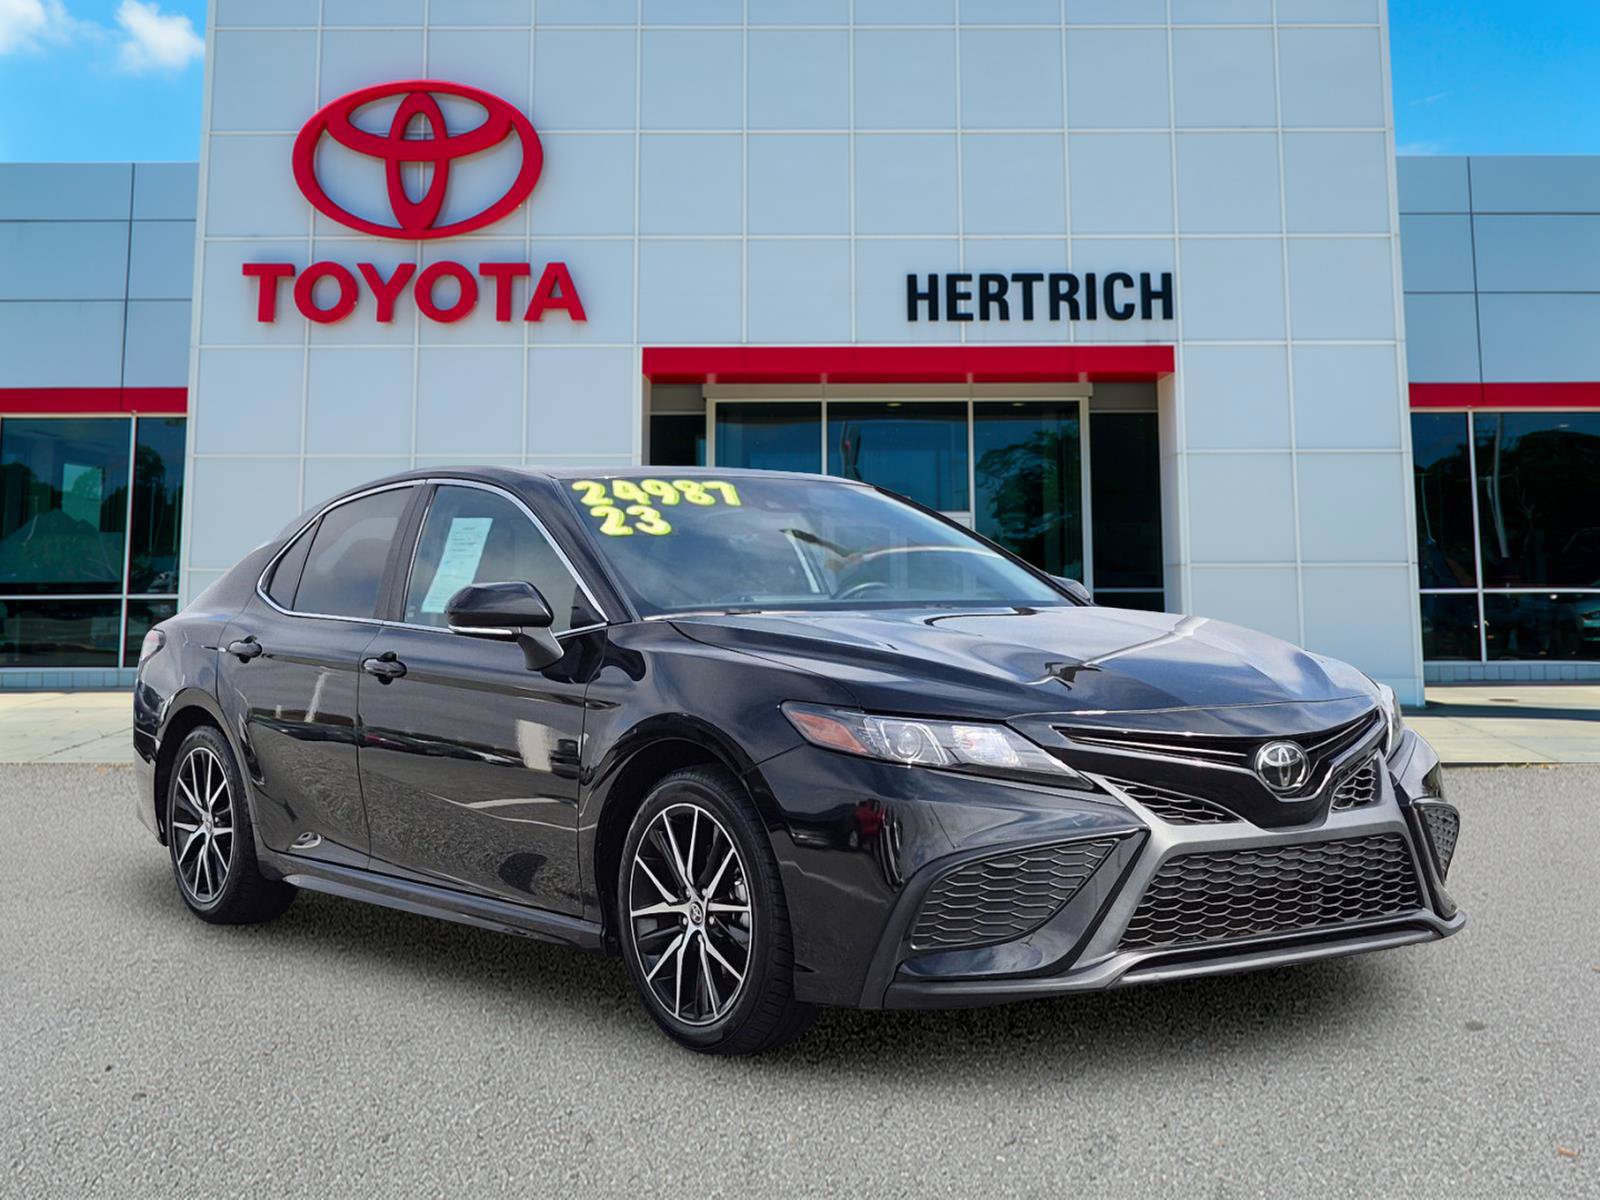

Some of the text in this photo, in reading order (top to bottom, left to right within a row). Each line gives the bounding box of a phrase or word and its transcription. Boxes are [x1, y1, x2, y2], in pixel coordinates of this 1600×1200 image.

[242, 261, 587, 323] TOYOTA
[906, 272, 1174, 322] HERTRICH
[571, 479, 742, 506] 24987
[590, 505, 672, 536] 23
